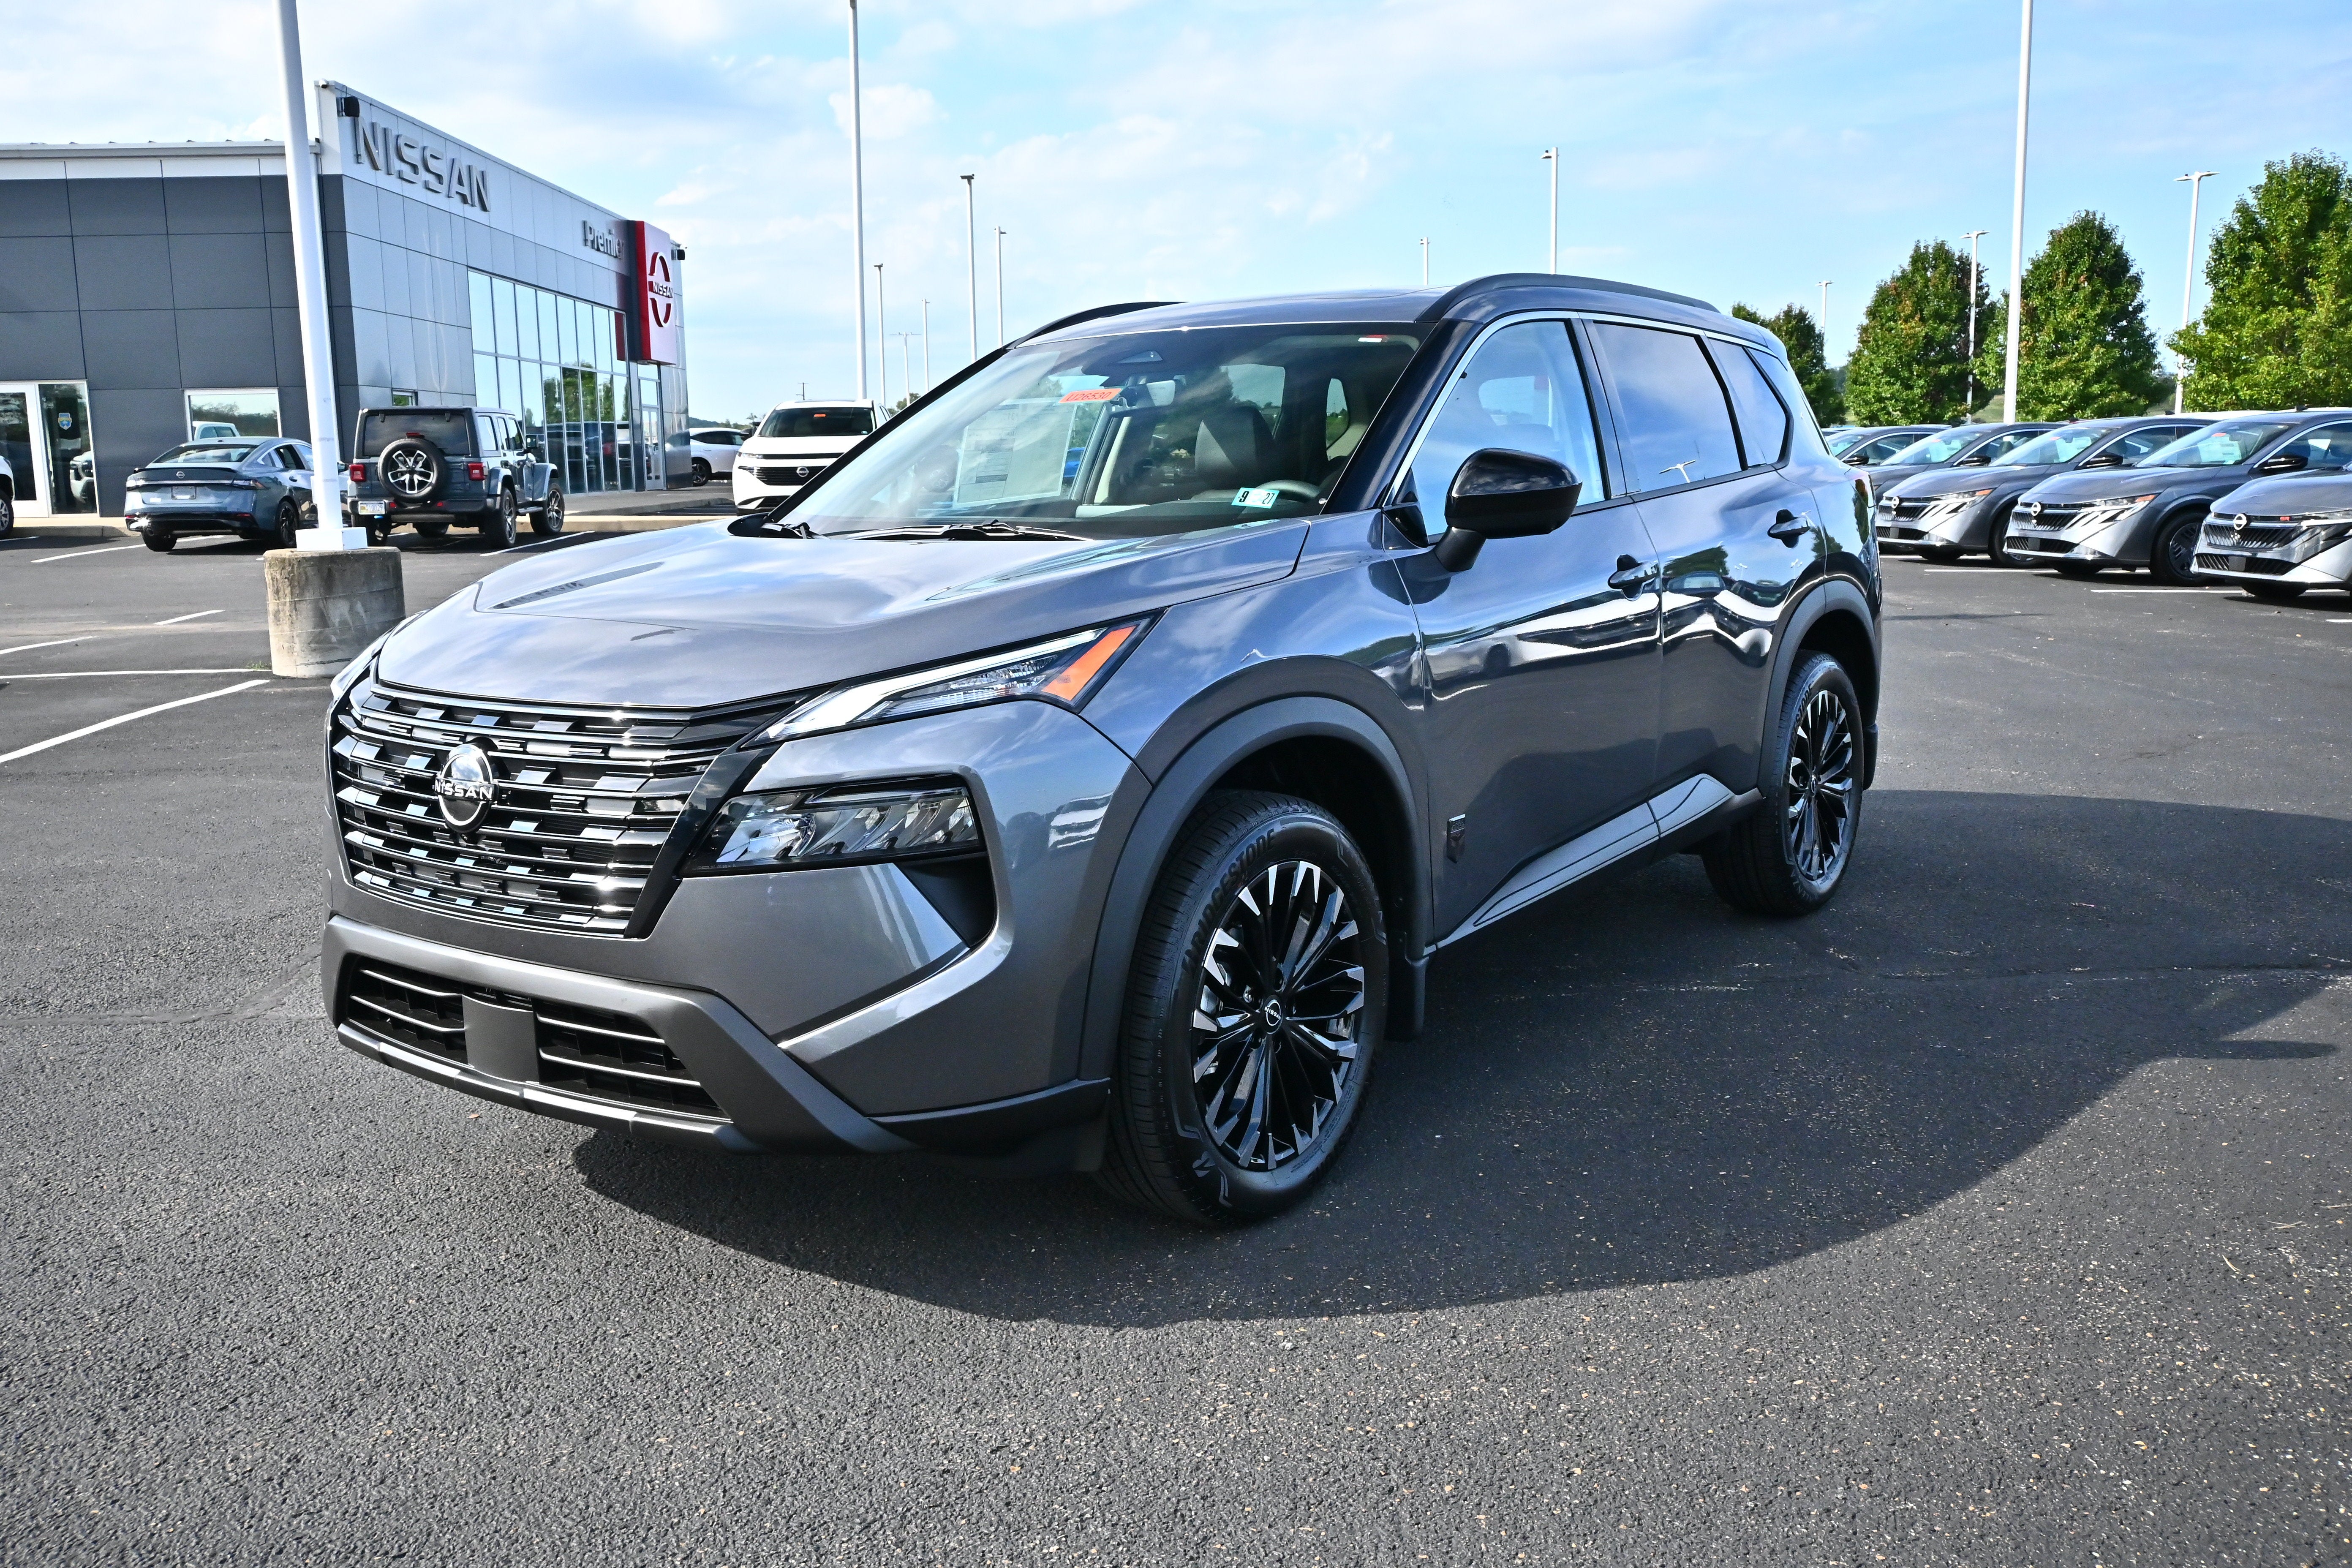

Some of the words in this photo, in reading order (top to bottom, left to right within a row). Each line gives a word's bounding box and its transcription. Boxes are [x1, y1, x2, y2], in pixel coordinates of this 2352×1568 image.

[352, 116, 490, 212] NISSAN
[582, 220, 624, 259] Premier
[653, 282, 673, 298] NISSAN
[1239, 490, 1250, 503] 9
[1262, 493, 1275, 504] 27
[434, 779, 493, 800] NISSAN
[1181, 828, 1275, 974] BRIDGESTONE
[1264, 1006, 1282, 1021] NISSAN
